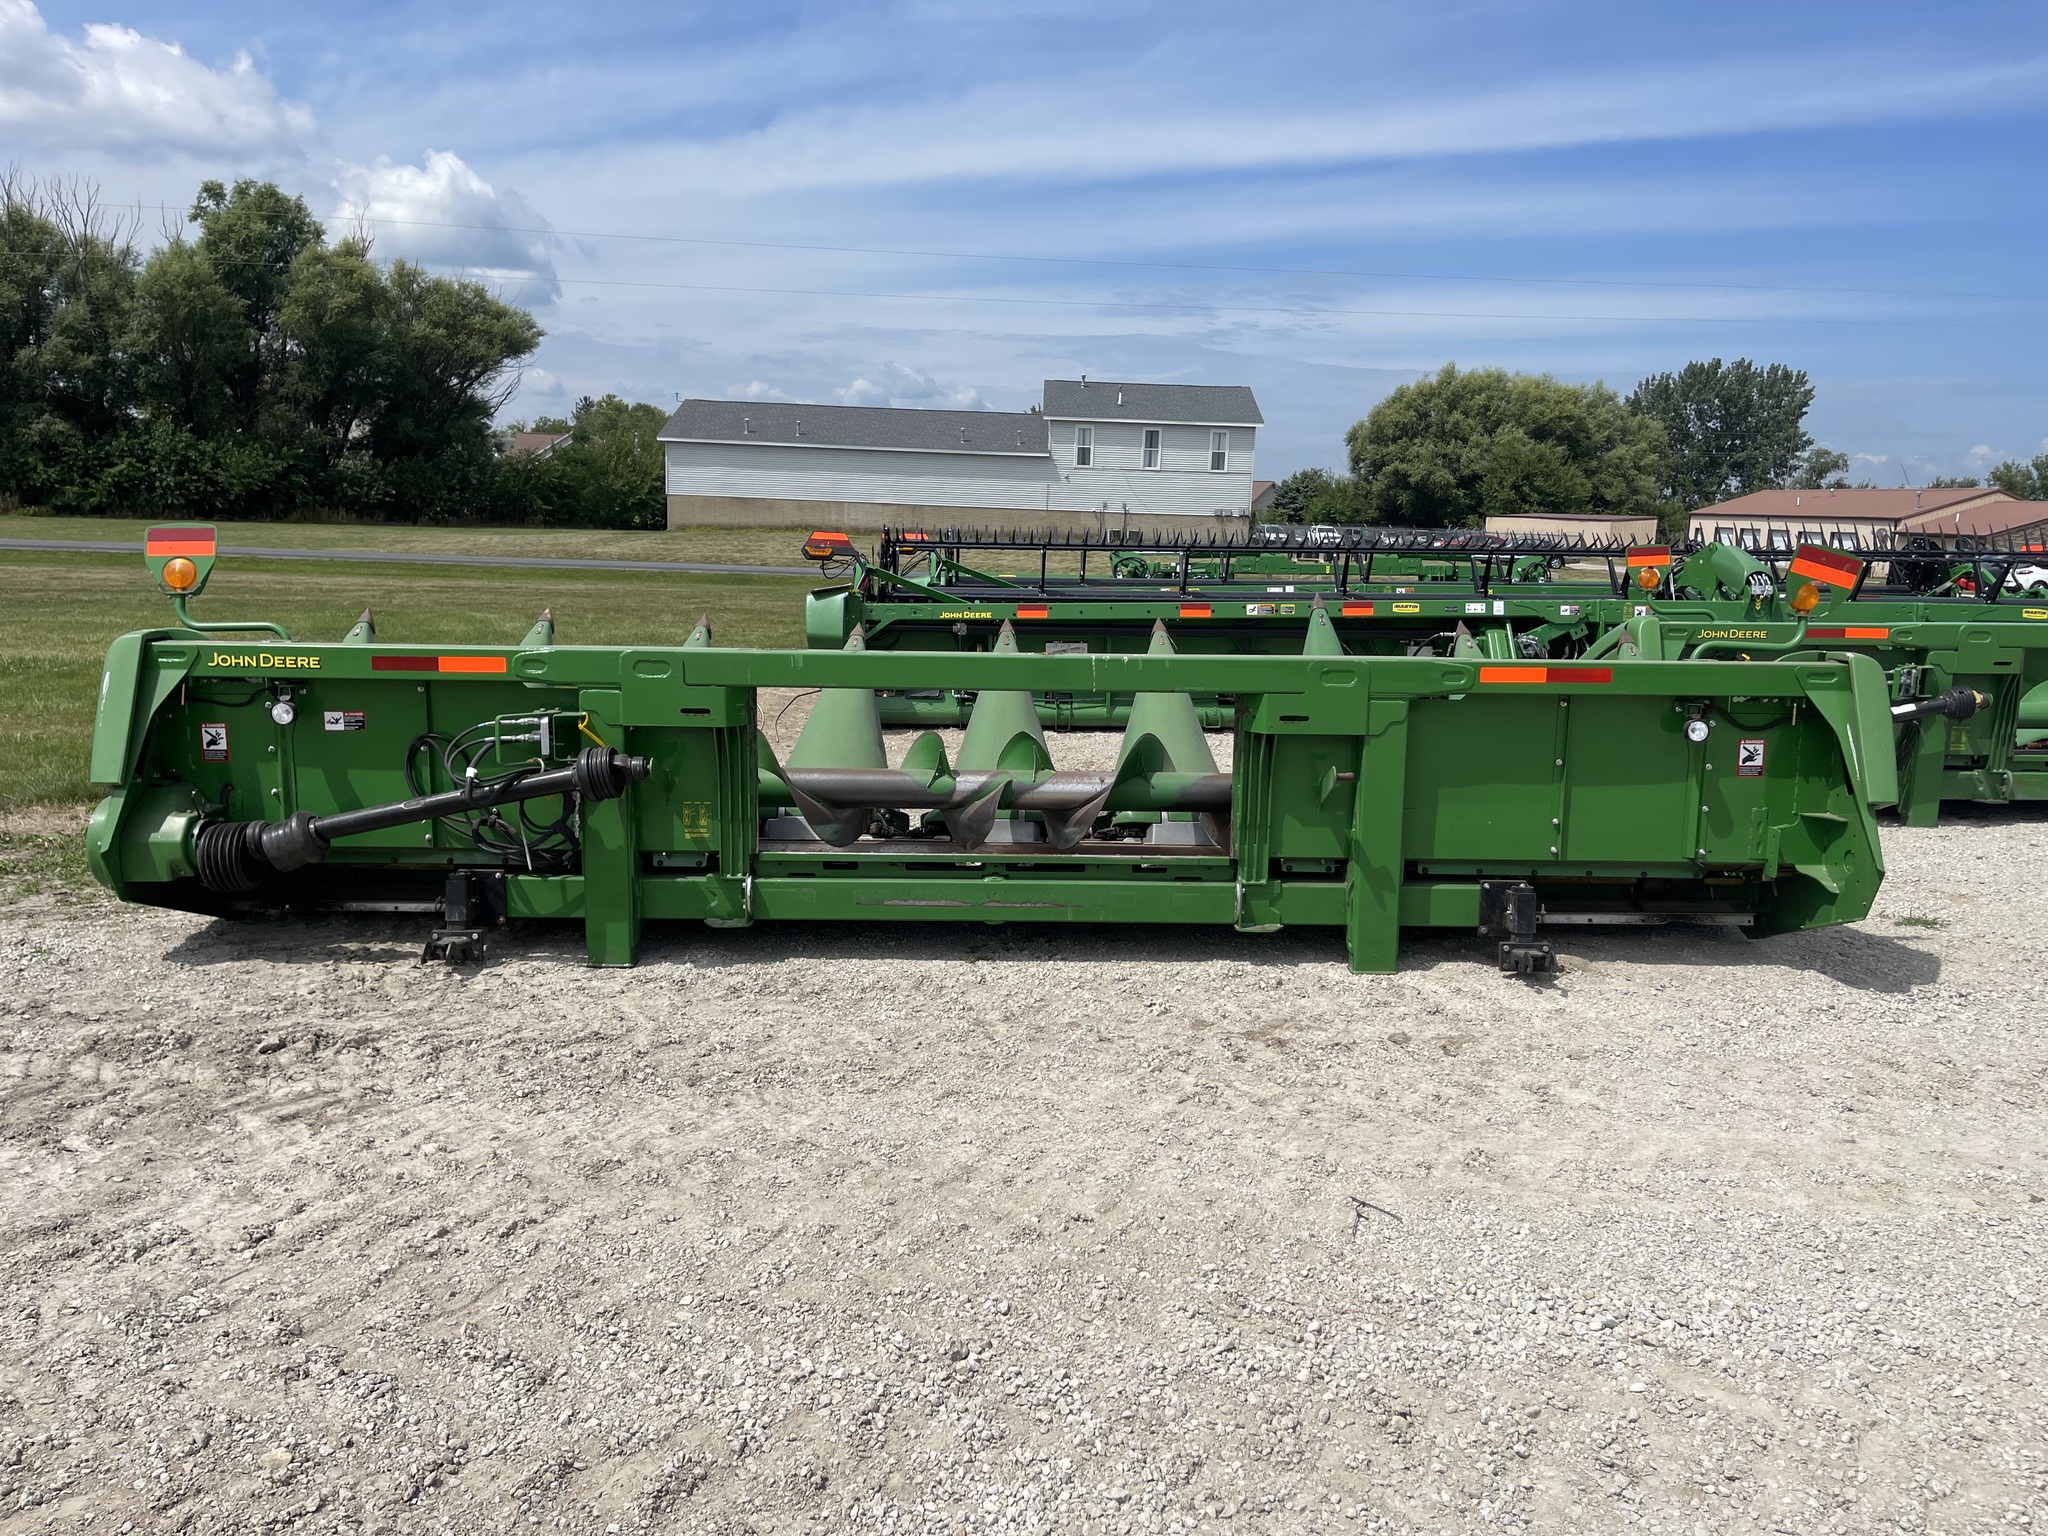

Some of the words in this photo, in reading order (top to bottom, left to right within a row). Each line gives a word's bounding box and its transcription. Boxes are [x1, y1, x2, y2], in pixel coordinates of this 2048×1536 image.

[940, 611, 962, 619] JOHN
[963, 611, 992, 619] DEERE
[1697, 629, 1728, 639] JOHN
[1729, 629, 1768, 639] DEERE
[208, 652, 257, 668] JOHN
[259, 653, 321, 669] DEERE
